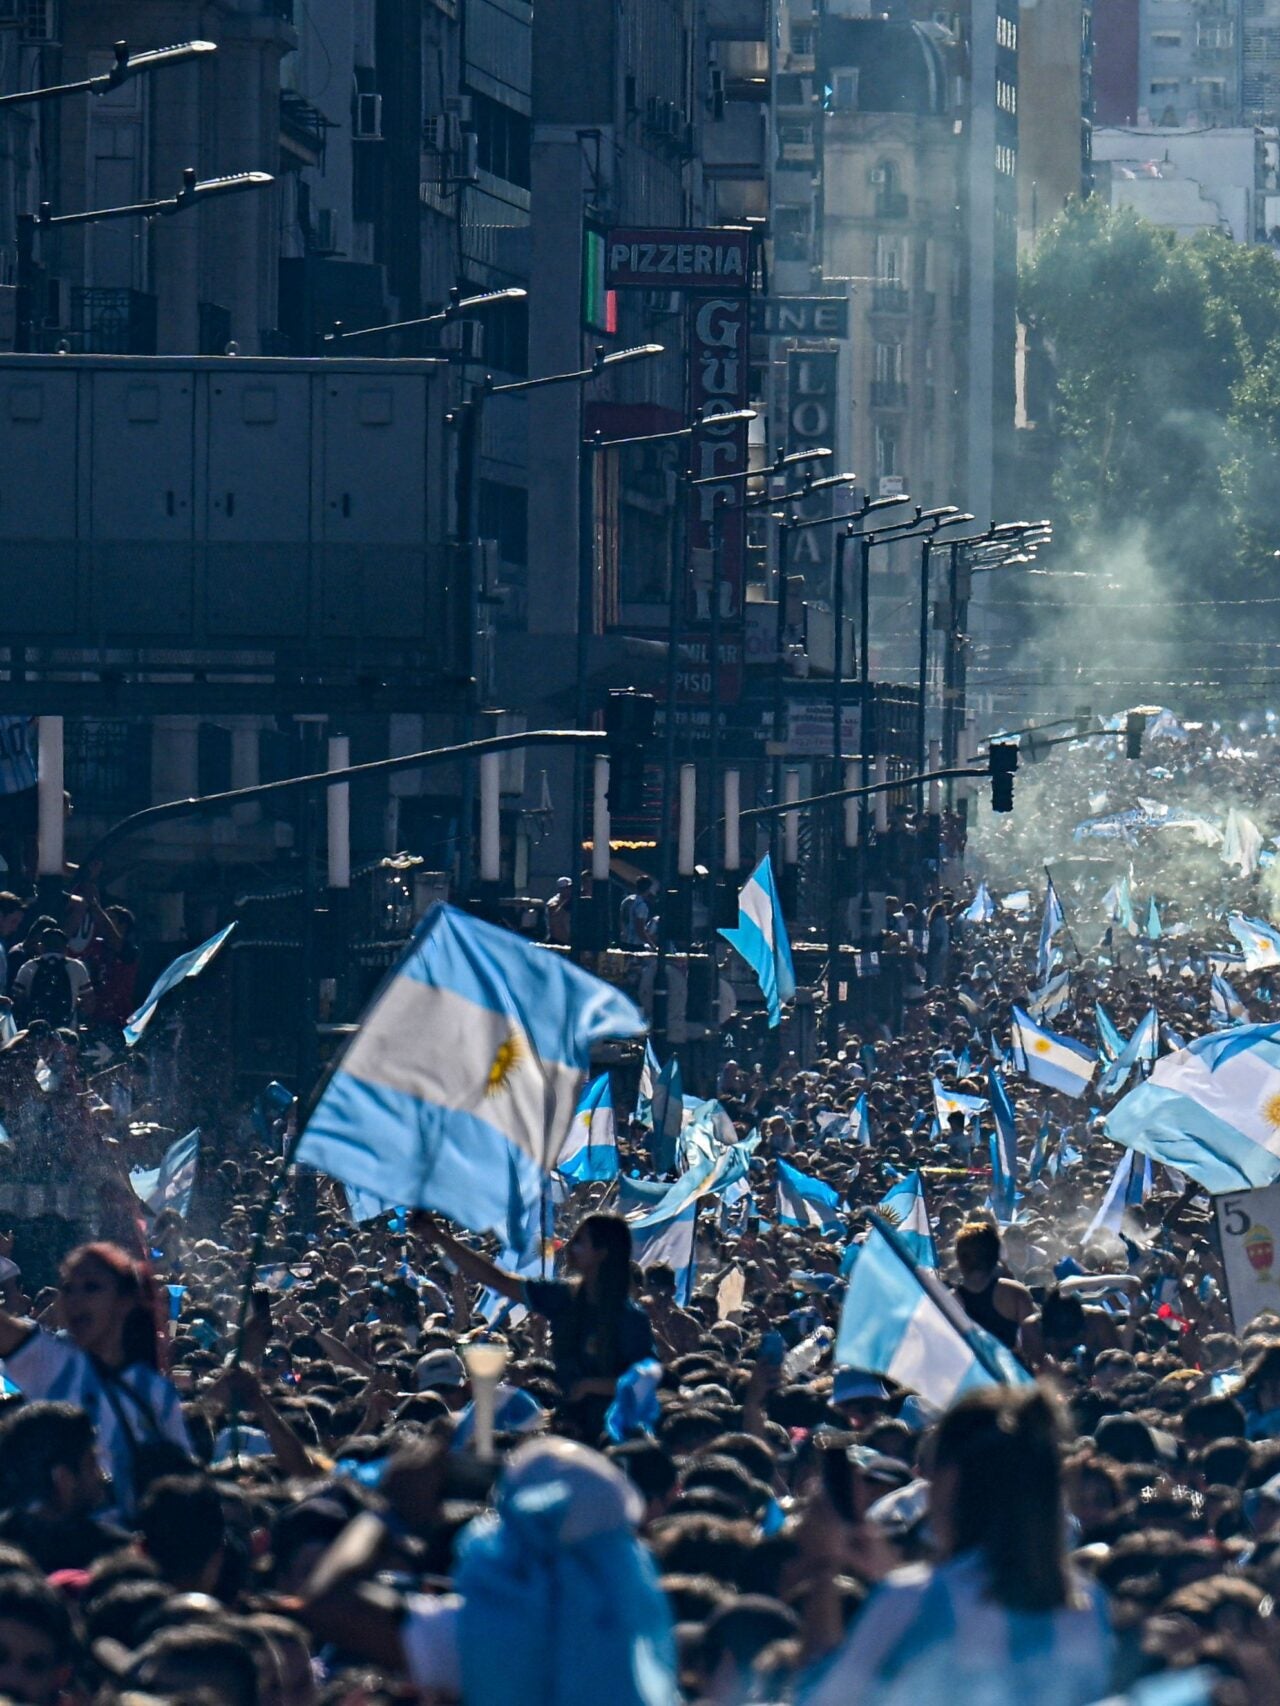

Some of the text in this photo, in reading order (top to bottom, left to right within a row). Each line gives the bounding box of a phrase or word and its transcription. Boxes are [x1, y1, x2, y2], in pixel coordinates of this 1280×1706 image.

[610, 244, 743, 276] PIZZERIA
[751, 307, 838, 329] INE
[1224, 1200, 1250, 1235] 5
